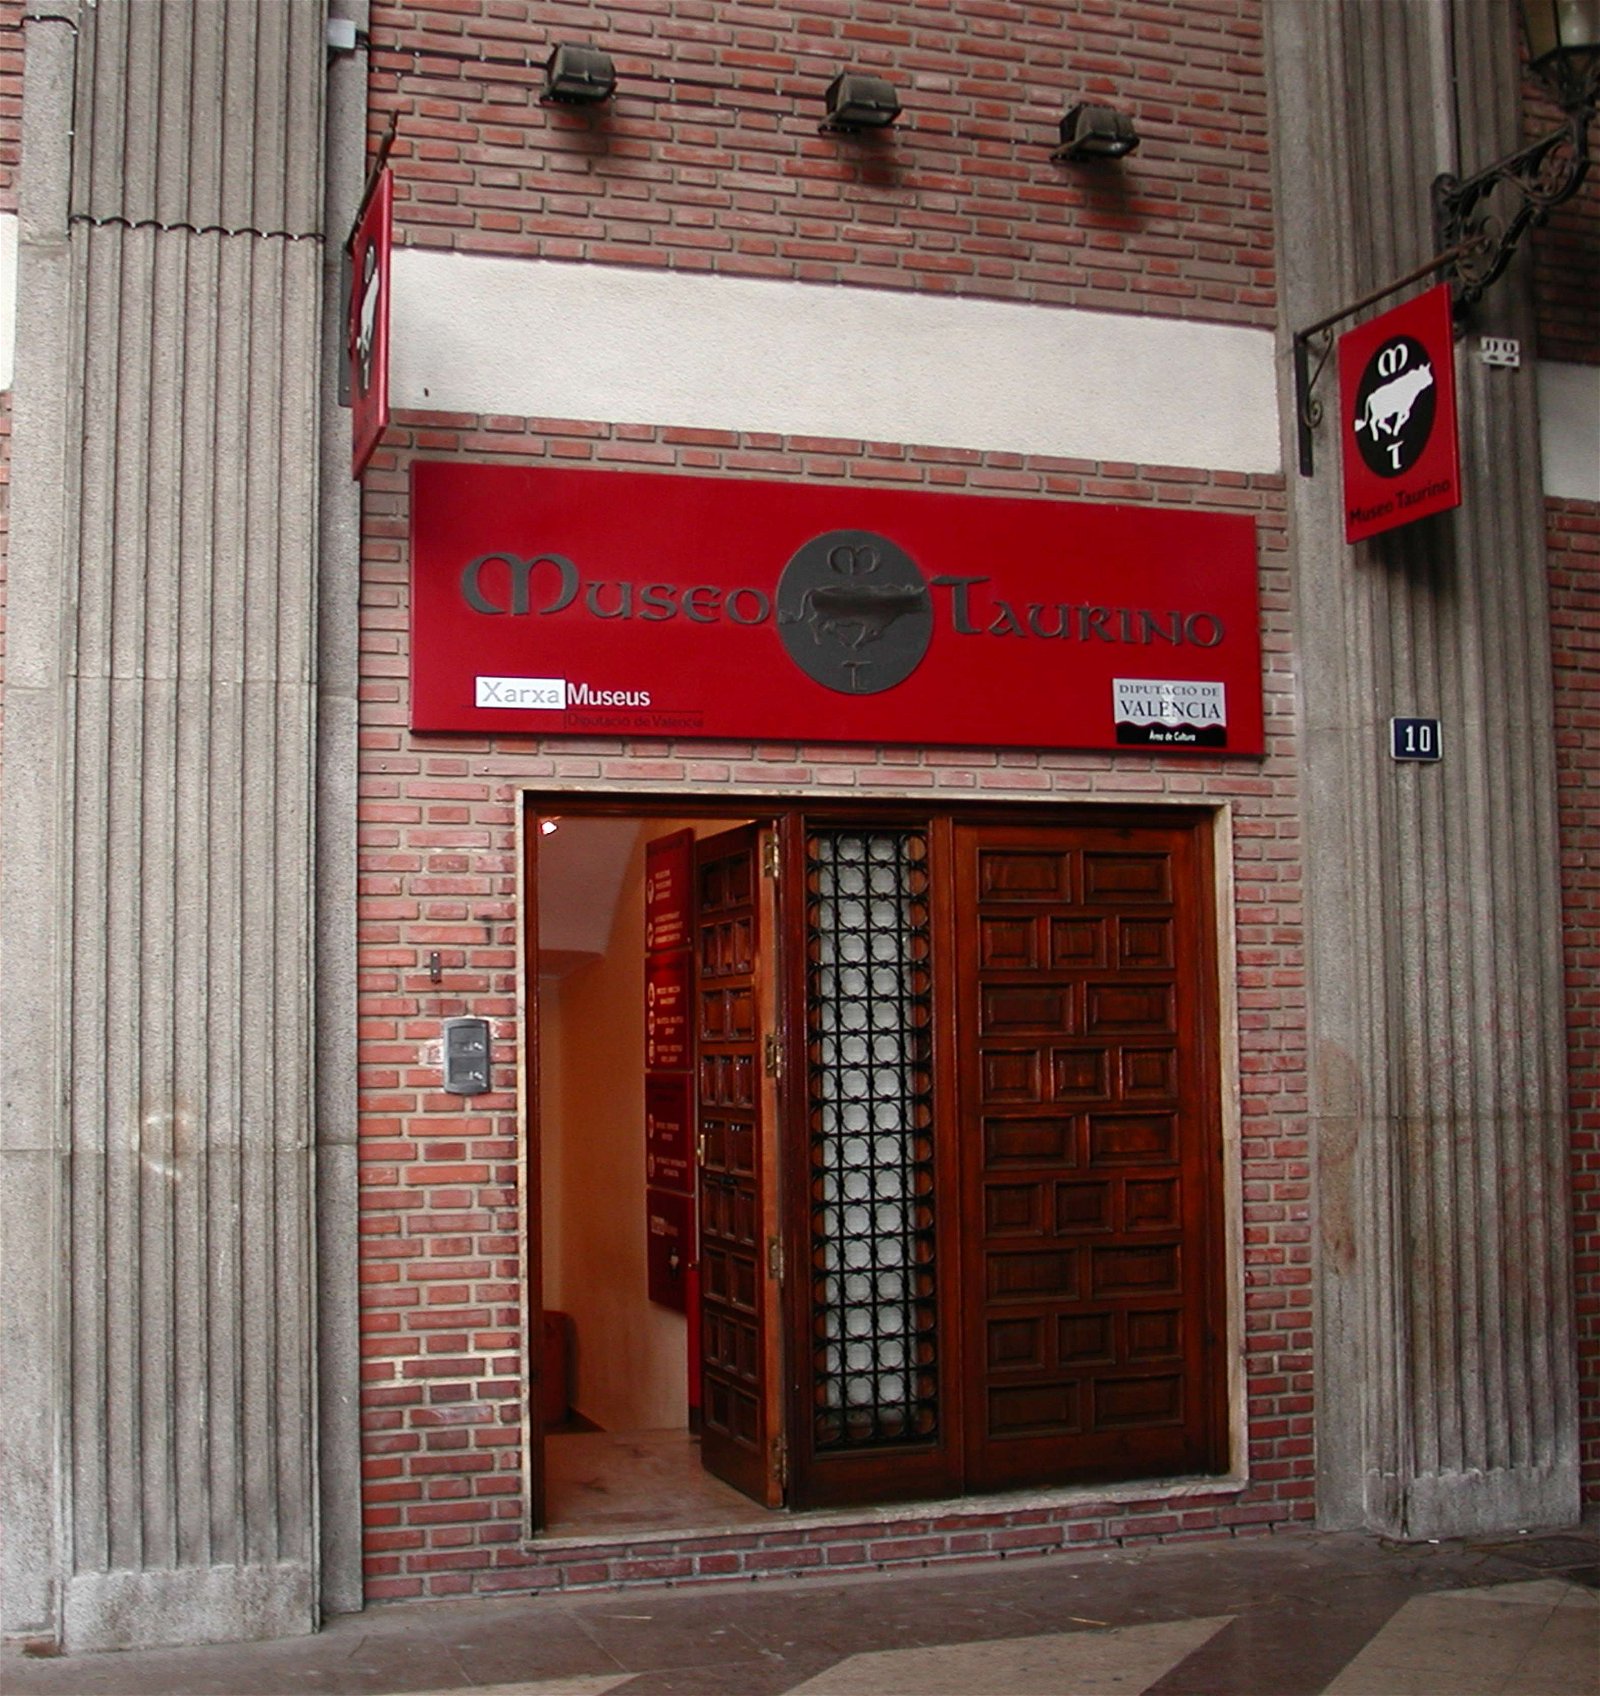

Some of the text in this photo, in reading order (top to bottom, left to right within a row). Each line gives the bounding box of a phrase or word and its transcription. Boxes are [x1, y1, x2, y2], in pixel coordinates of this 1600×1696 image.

[1350, 480, 1451, 526] Museo Taurino
[482, 681, 651, 707] Xarxa Museus
[1201, 687, 1220, 698] DE
[634, 713, 650, 727] de
[1404, 724, 1432, 752] 10
